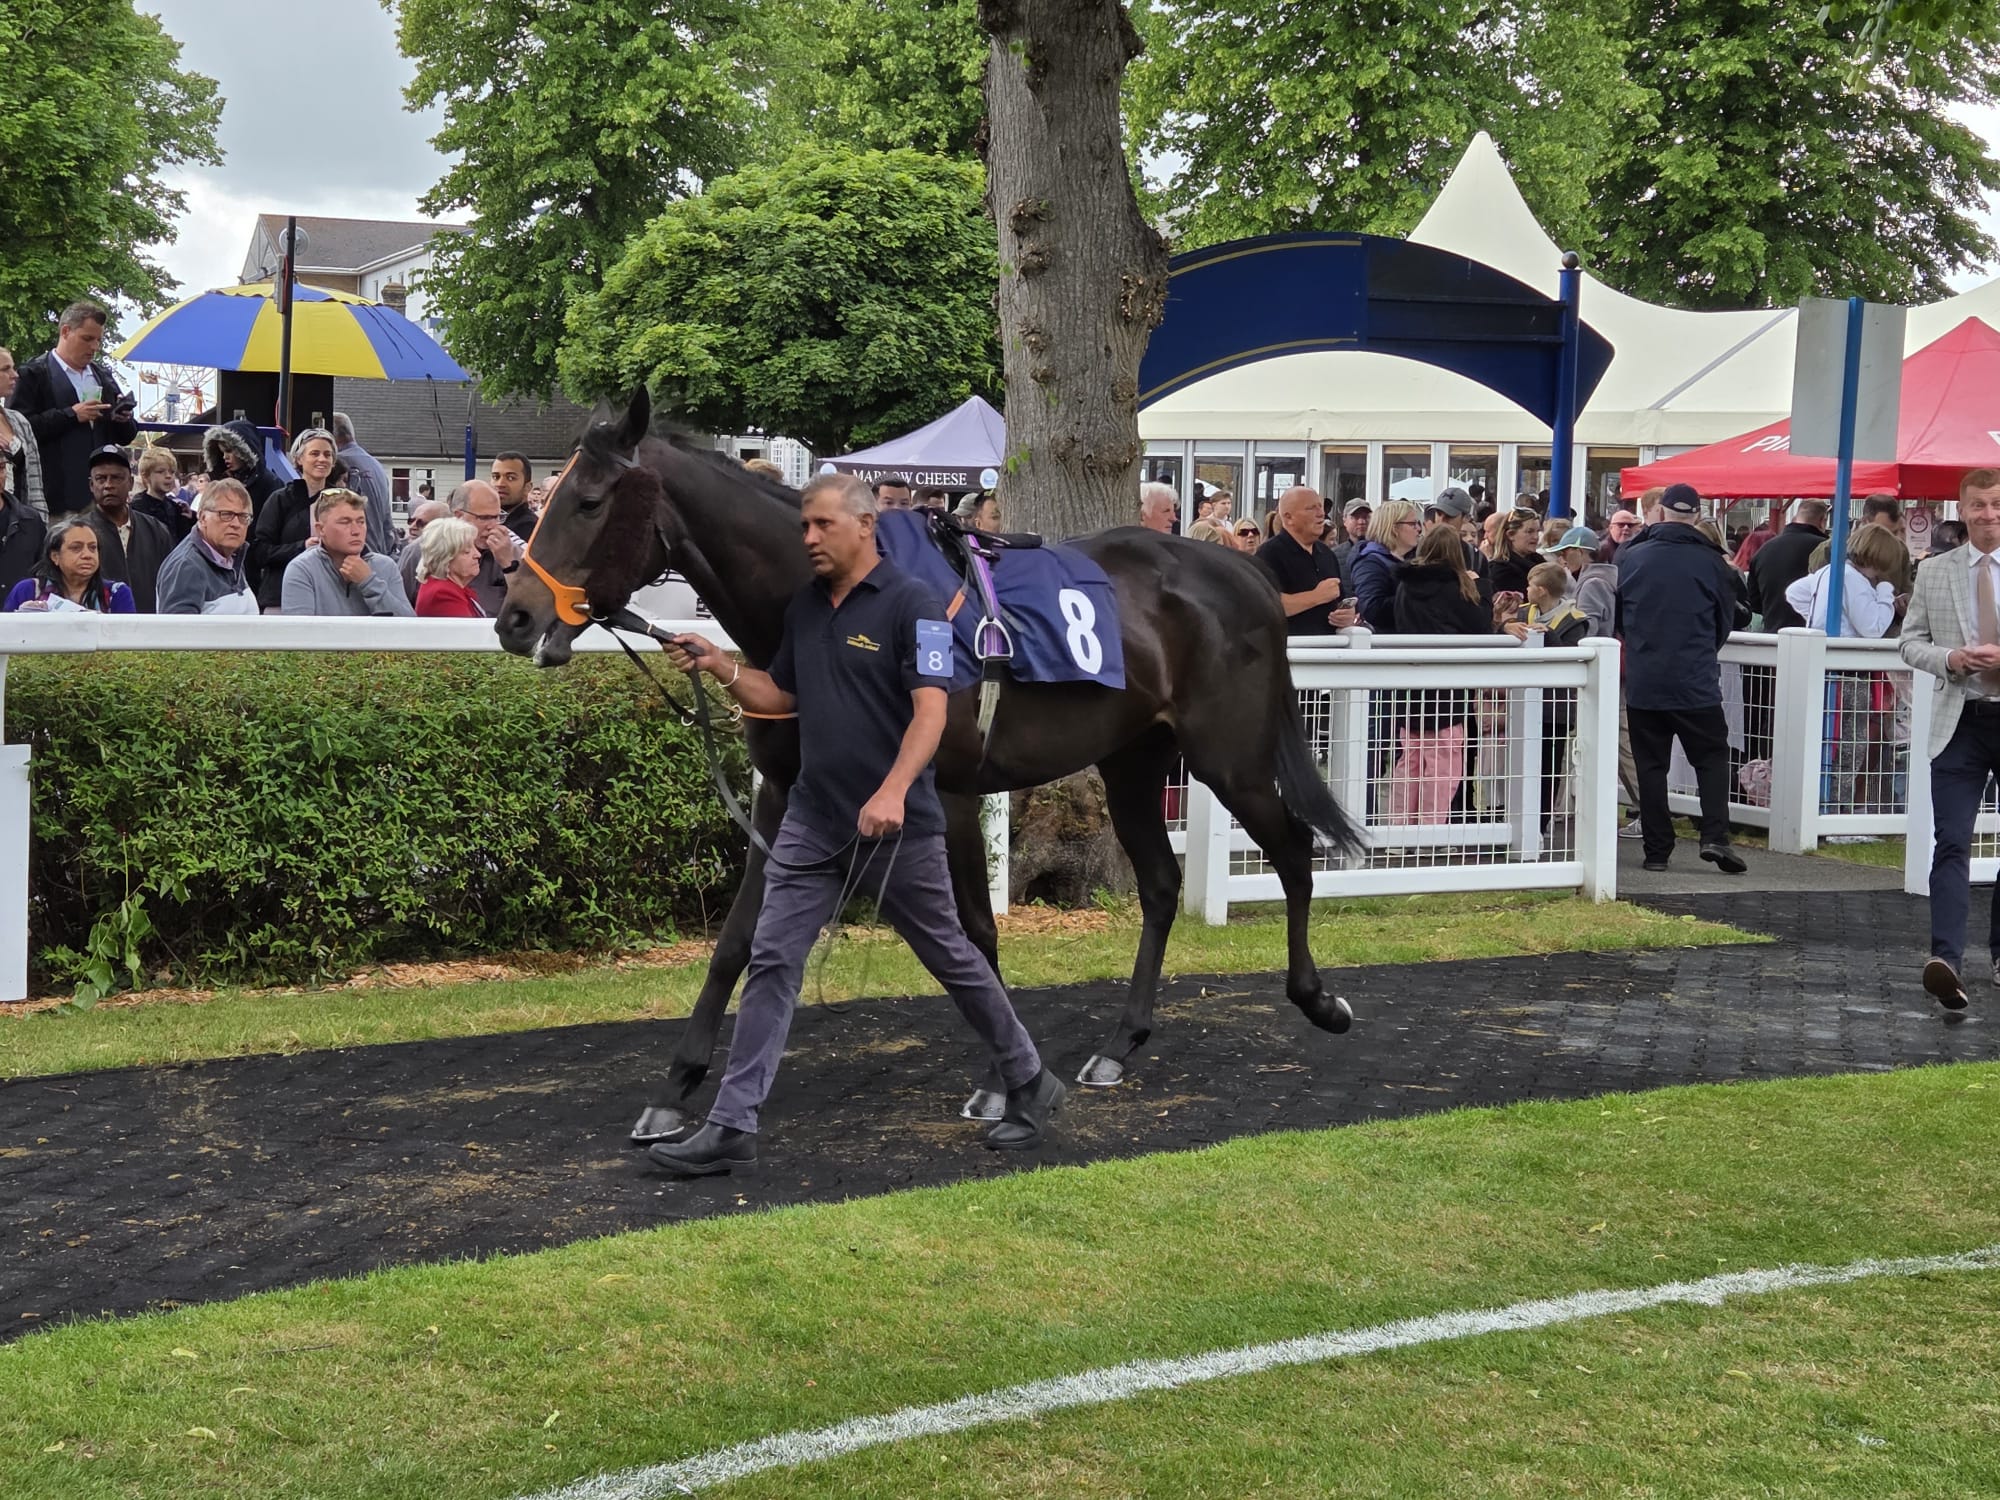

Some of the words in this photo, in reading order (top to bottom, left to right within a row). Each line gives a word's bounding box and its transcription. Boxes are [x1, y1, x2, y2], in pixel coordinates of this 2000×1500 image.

[853, 469, 912, 484] MARW
[915, 472, 967, 486] CHEESE
[1059, 589, 1103, 674] 8
[929, 650, 943, 671] 8
